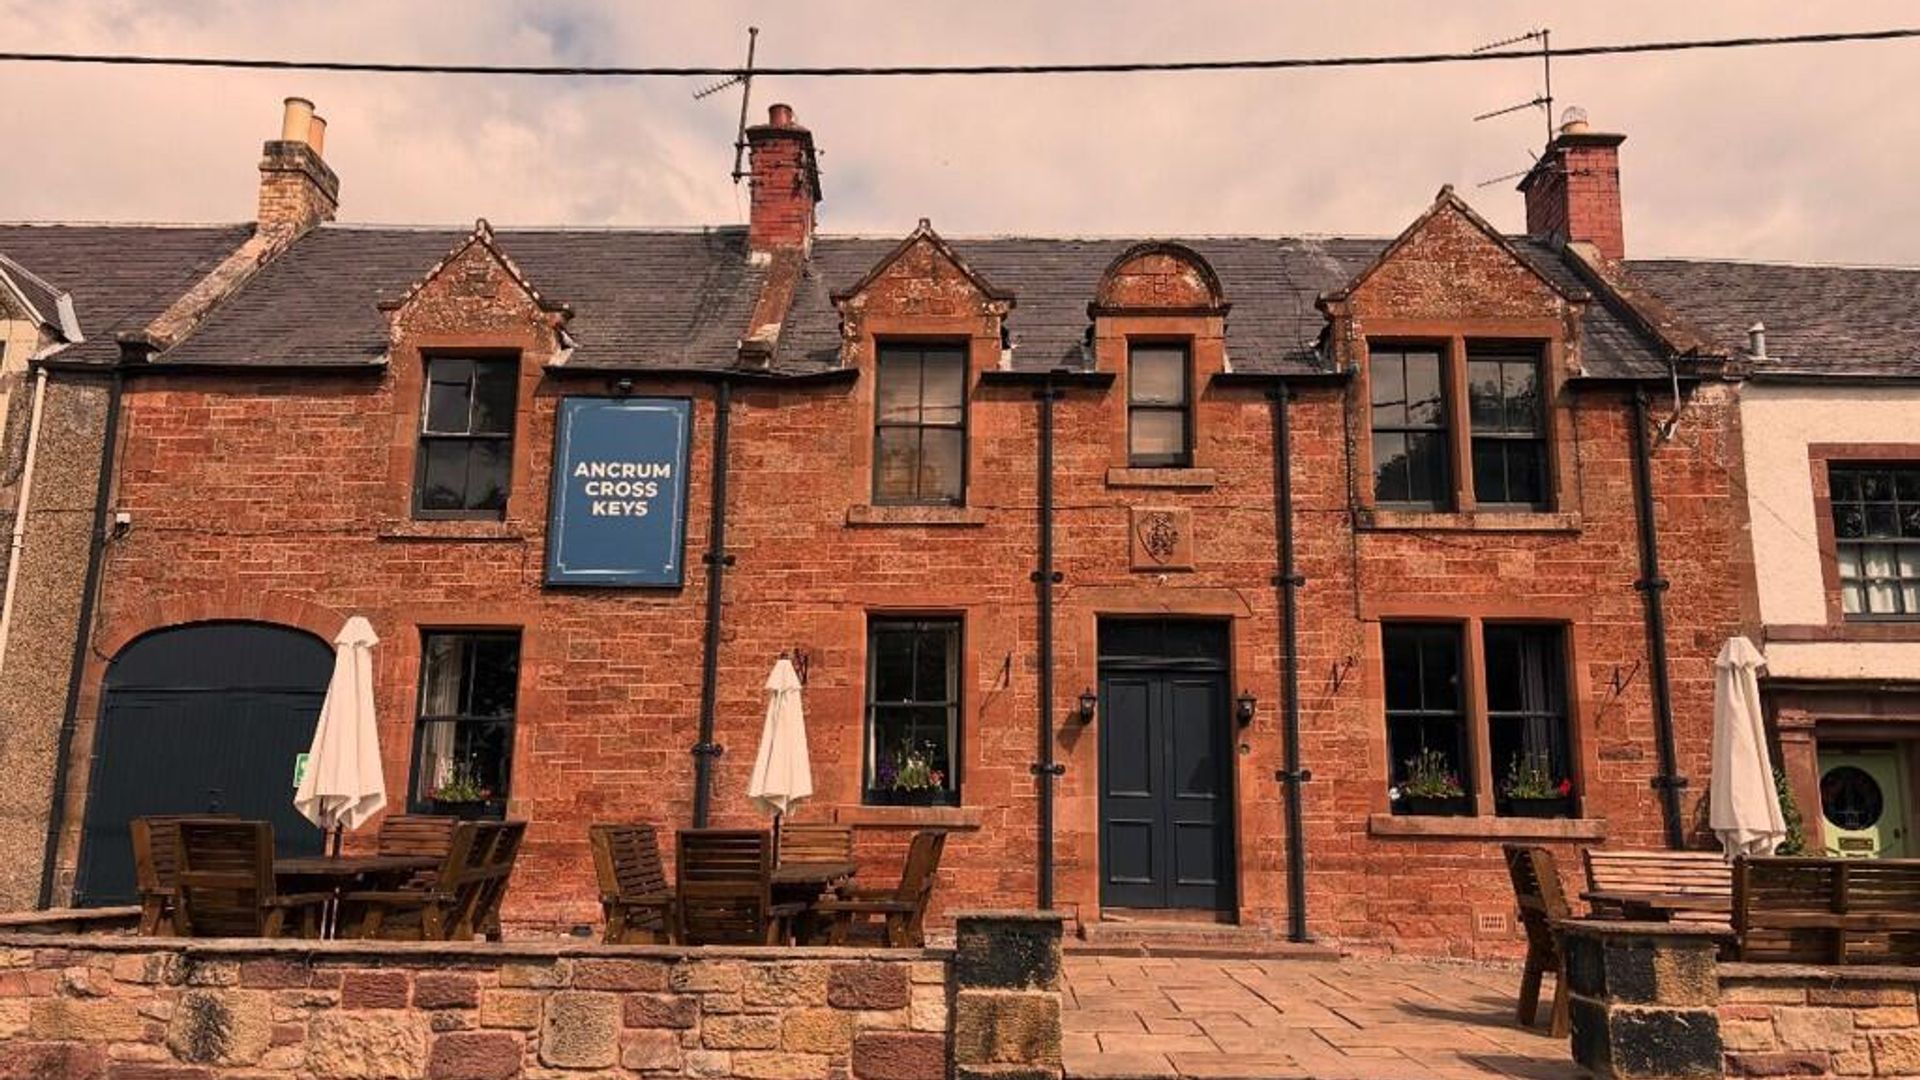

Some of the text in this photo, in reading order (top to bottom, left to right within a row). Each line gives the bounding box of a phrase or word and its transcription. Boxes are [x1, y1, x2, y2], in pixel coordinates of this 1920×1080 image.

[574, 462, 671, 479] ANCRUM
[584, 481, 658, 498] CROSS
[592, 500, 648, 517] KEYS
